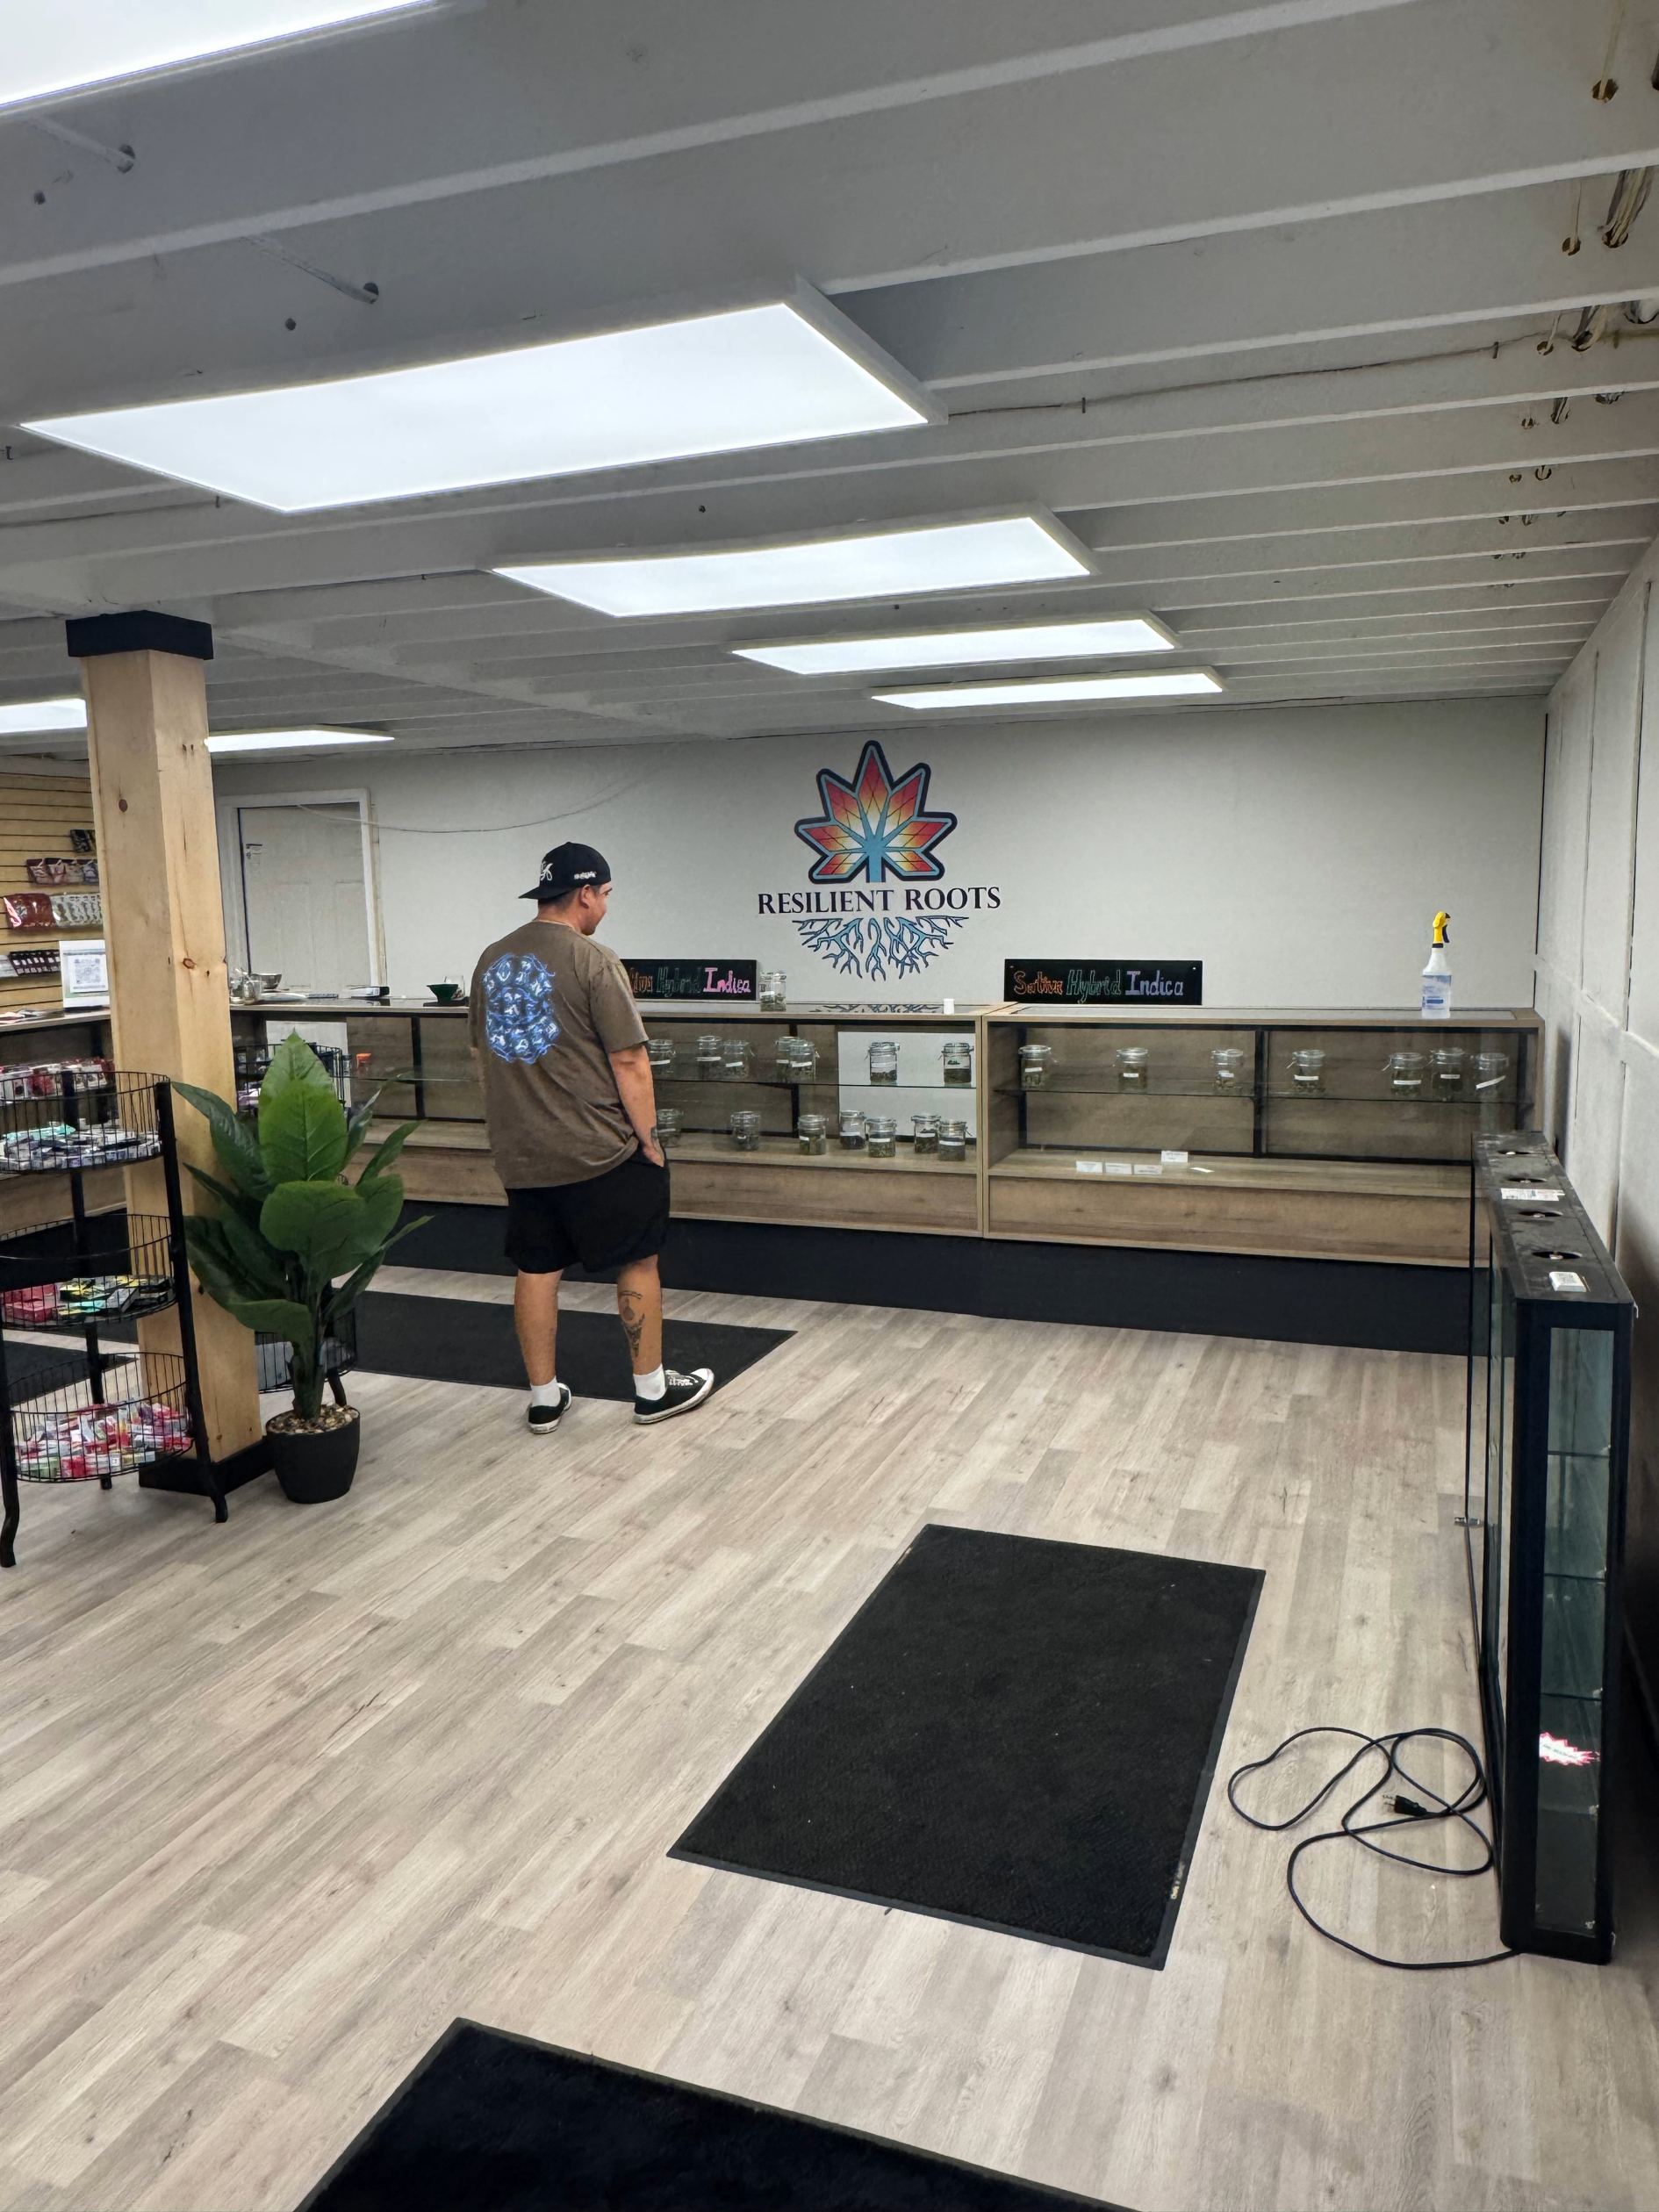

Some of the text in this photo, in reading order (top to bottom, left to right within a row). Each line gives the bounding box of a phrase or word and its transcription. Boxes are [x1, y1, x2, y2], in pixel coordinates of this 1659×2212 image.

[758, 887, 1001, 914] RESILIENT ROOTS
[629, 967, 751, 997] tiva Hybrid Indica
[1014, 969, 1183, 1003] Sativa Hybrid Indica
